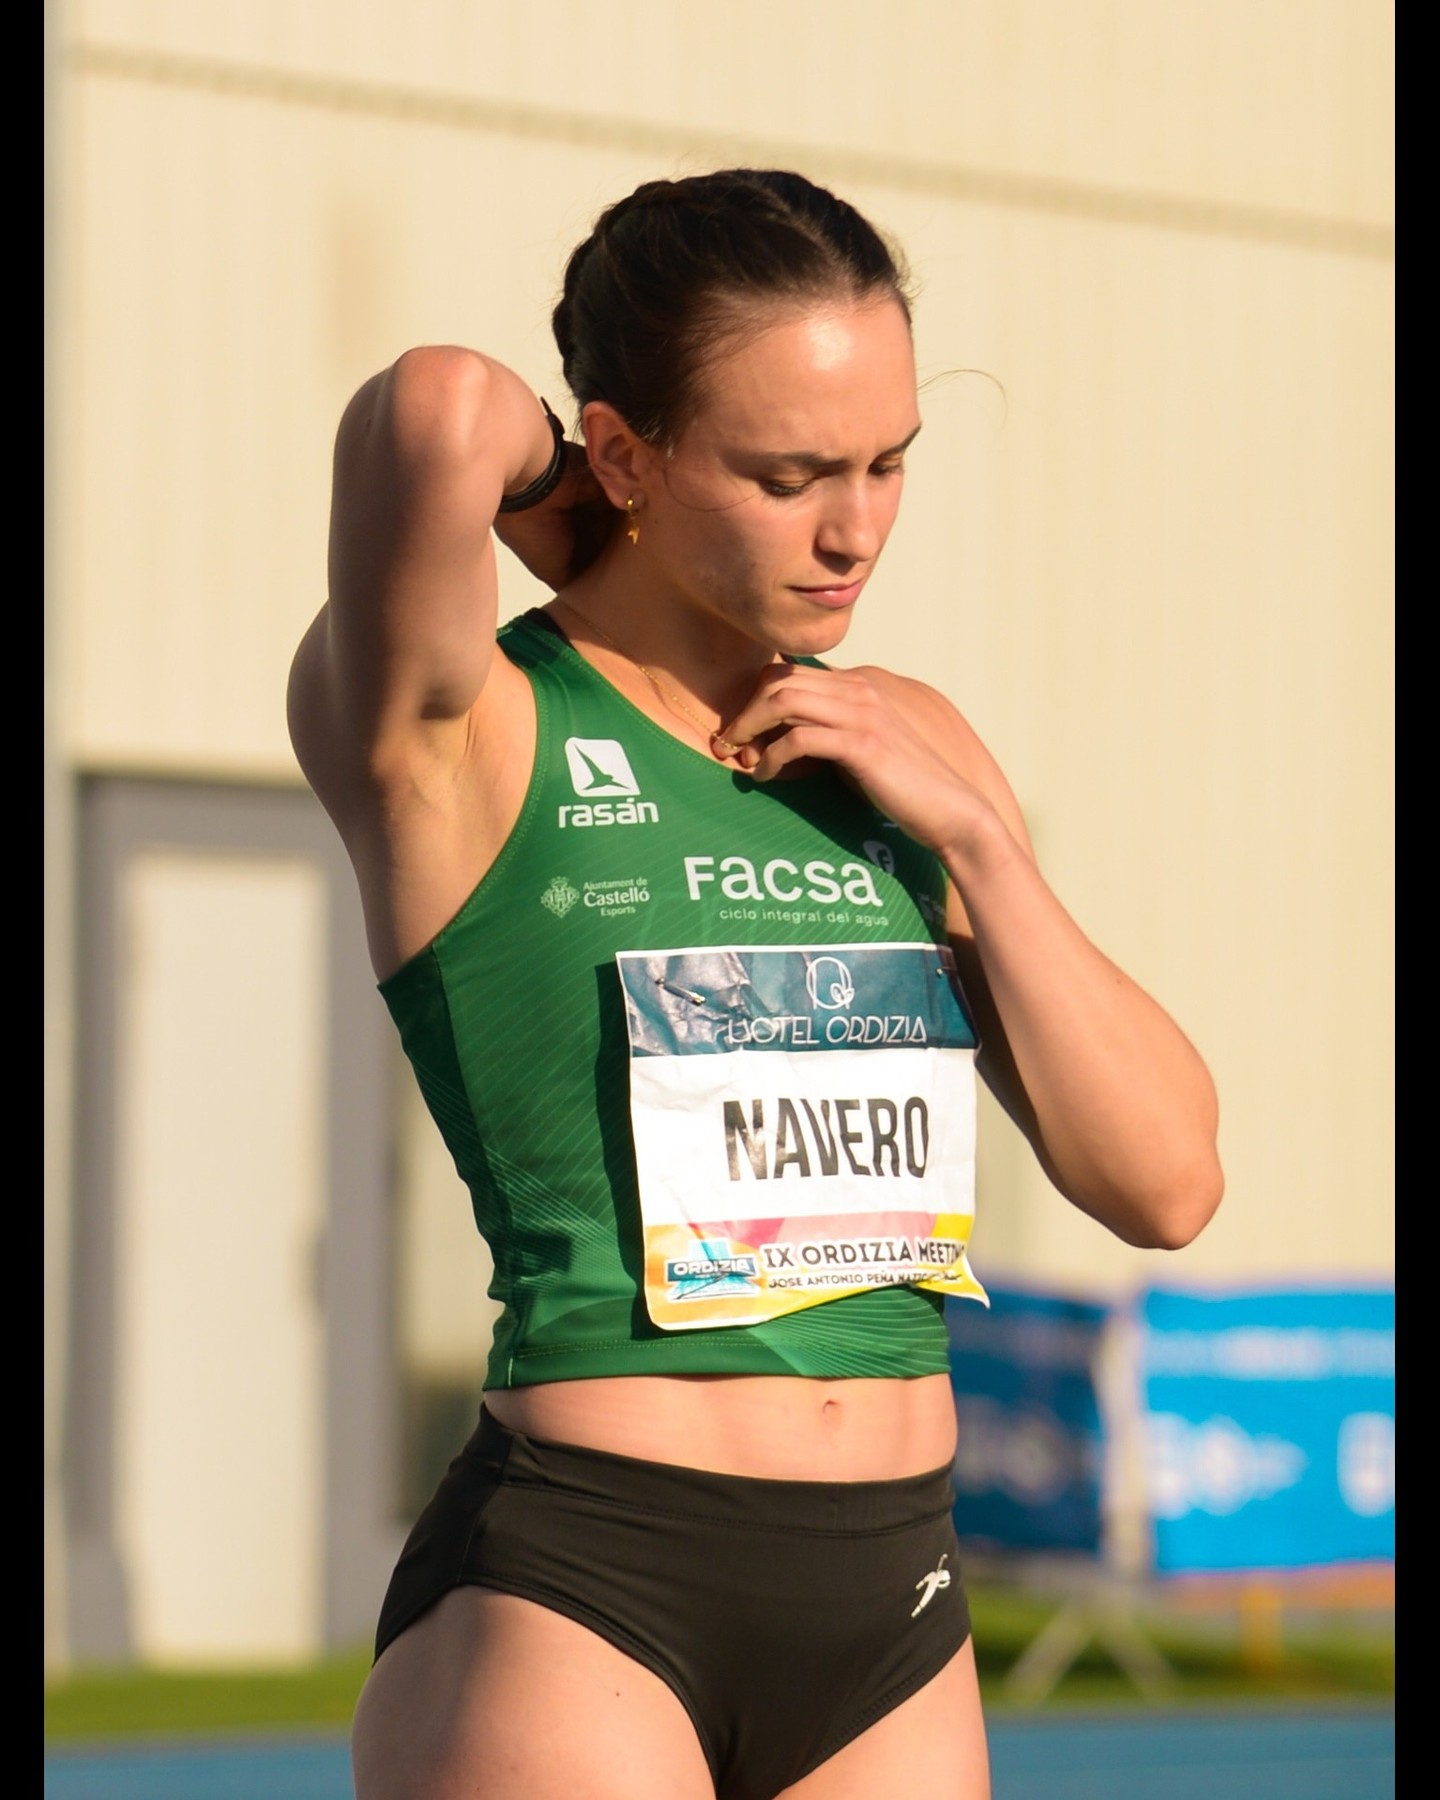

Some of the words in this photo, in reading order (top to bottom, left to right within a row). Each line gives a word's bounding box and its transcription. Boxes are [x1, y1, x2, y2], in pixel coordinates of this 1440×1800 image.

[559, 797, 659, 828] rasán
[583, 880, 634, 892] Ajuntament
[636, 877, 648, 887] de
[583, 887, 650, 907] Castelló
[600, 906, 636, 918] Esports
[719, 908, 757, 920] ciclo
[762, 909, 821, 924] integral
[826, 911, 850, 923] del
[855, 914, 889, 927] agua
[728, 1016, 820, 1044] HOTEL
[825, 1015, 928, 1043] ORDIZIA
[723, 1096, 929, 1181] NAVERO
[764, 1247, 794, 1268] IX
[801, 1240, 913, 1266] ORDIZIA
[673, 1258, 750, 1276] ORDIZIA
[768, 1277, 803, 1288] JOSE
[807, 1273, 863, 1285] ANTONIO
[867, 1269, 894, 1283] PEÑA
